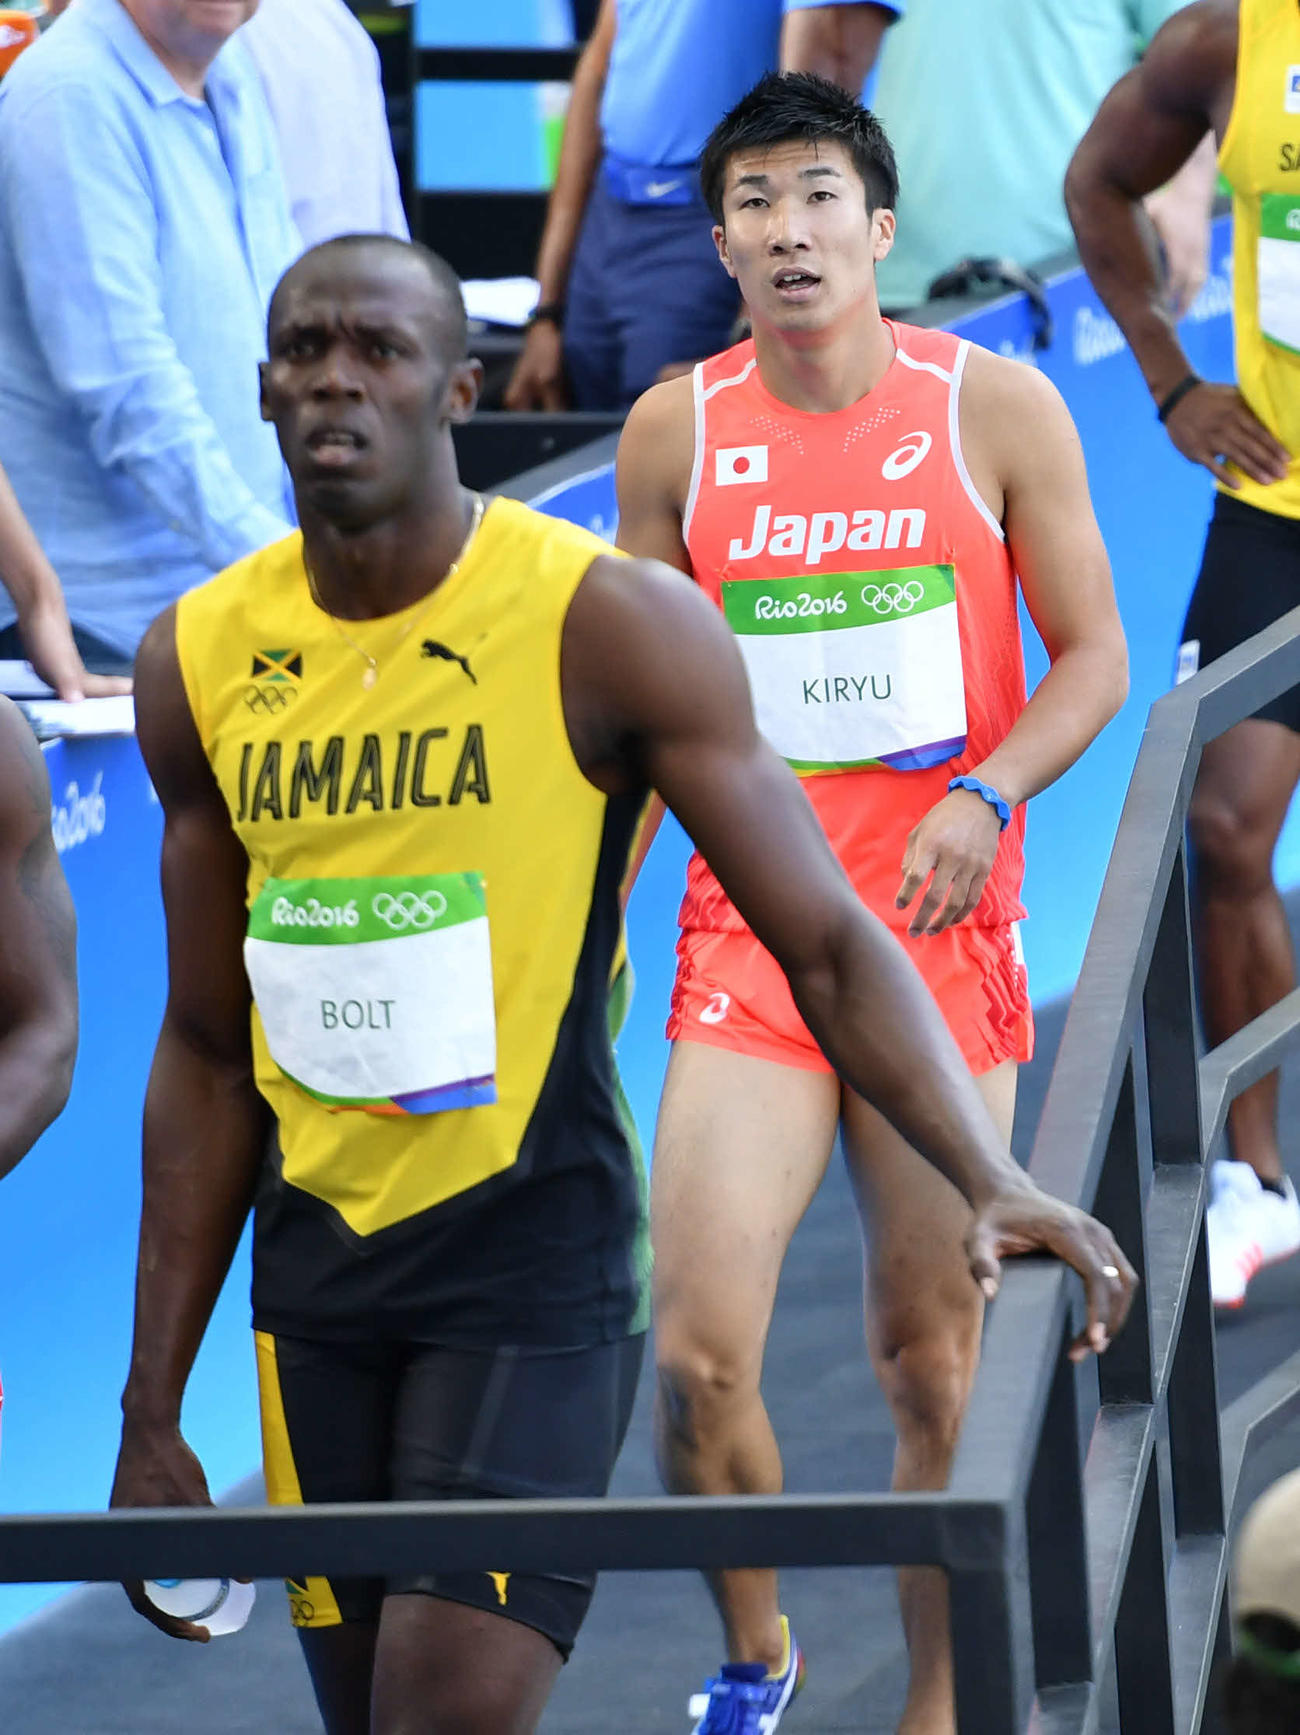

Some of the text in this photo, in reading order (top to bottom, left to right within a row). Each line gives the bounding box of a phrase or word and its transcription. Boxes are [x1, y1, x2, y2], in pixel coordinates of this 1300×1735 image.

[729, 505, 926, 564] Japan
[755, 591, 847, 620] Rio2016
[802, 674, 892, 704] KIRYU
[238, 723, 491, 822] JAMAICA
[272, 896, 360, 928] Rio2016
[320, 999, 396, 1030] BOLT
